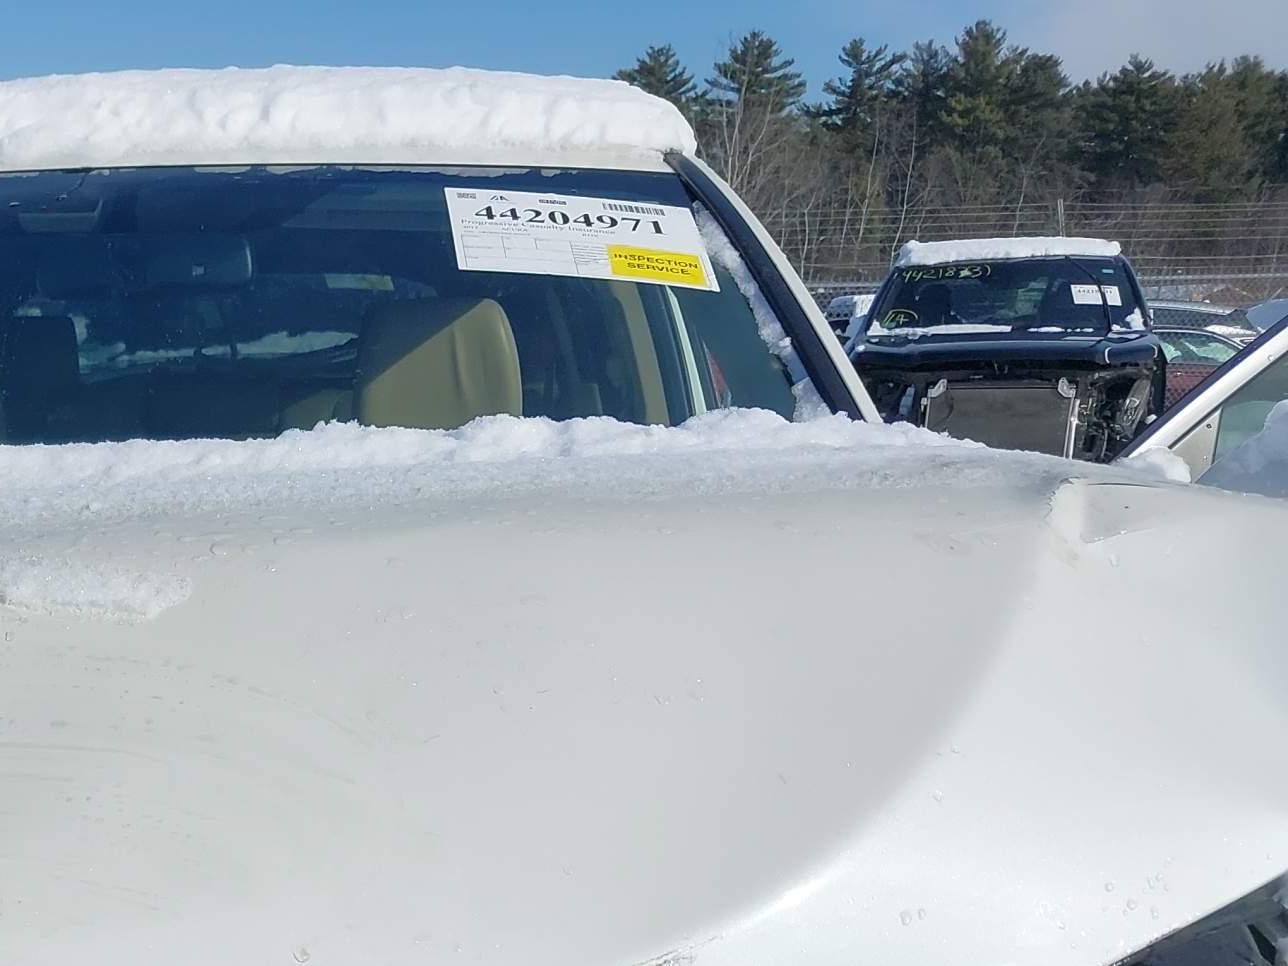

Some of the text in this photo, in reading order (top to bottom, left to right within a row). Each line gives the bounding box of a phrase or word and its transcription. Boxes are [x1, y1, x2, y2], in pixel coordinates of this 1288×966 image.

[474, 205, 668, 236] 44204971
[614, 253, 698, 269] INSPECTION
[626, 262, 691, 275] SERVICE
